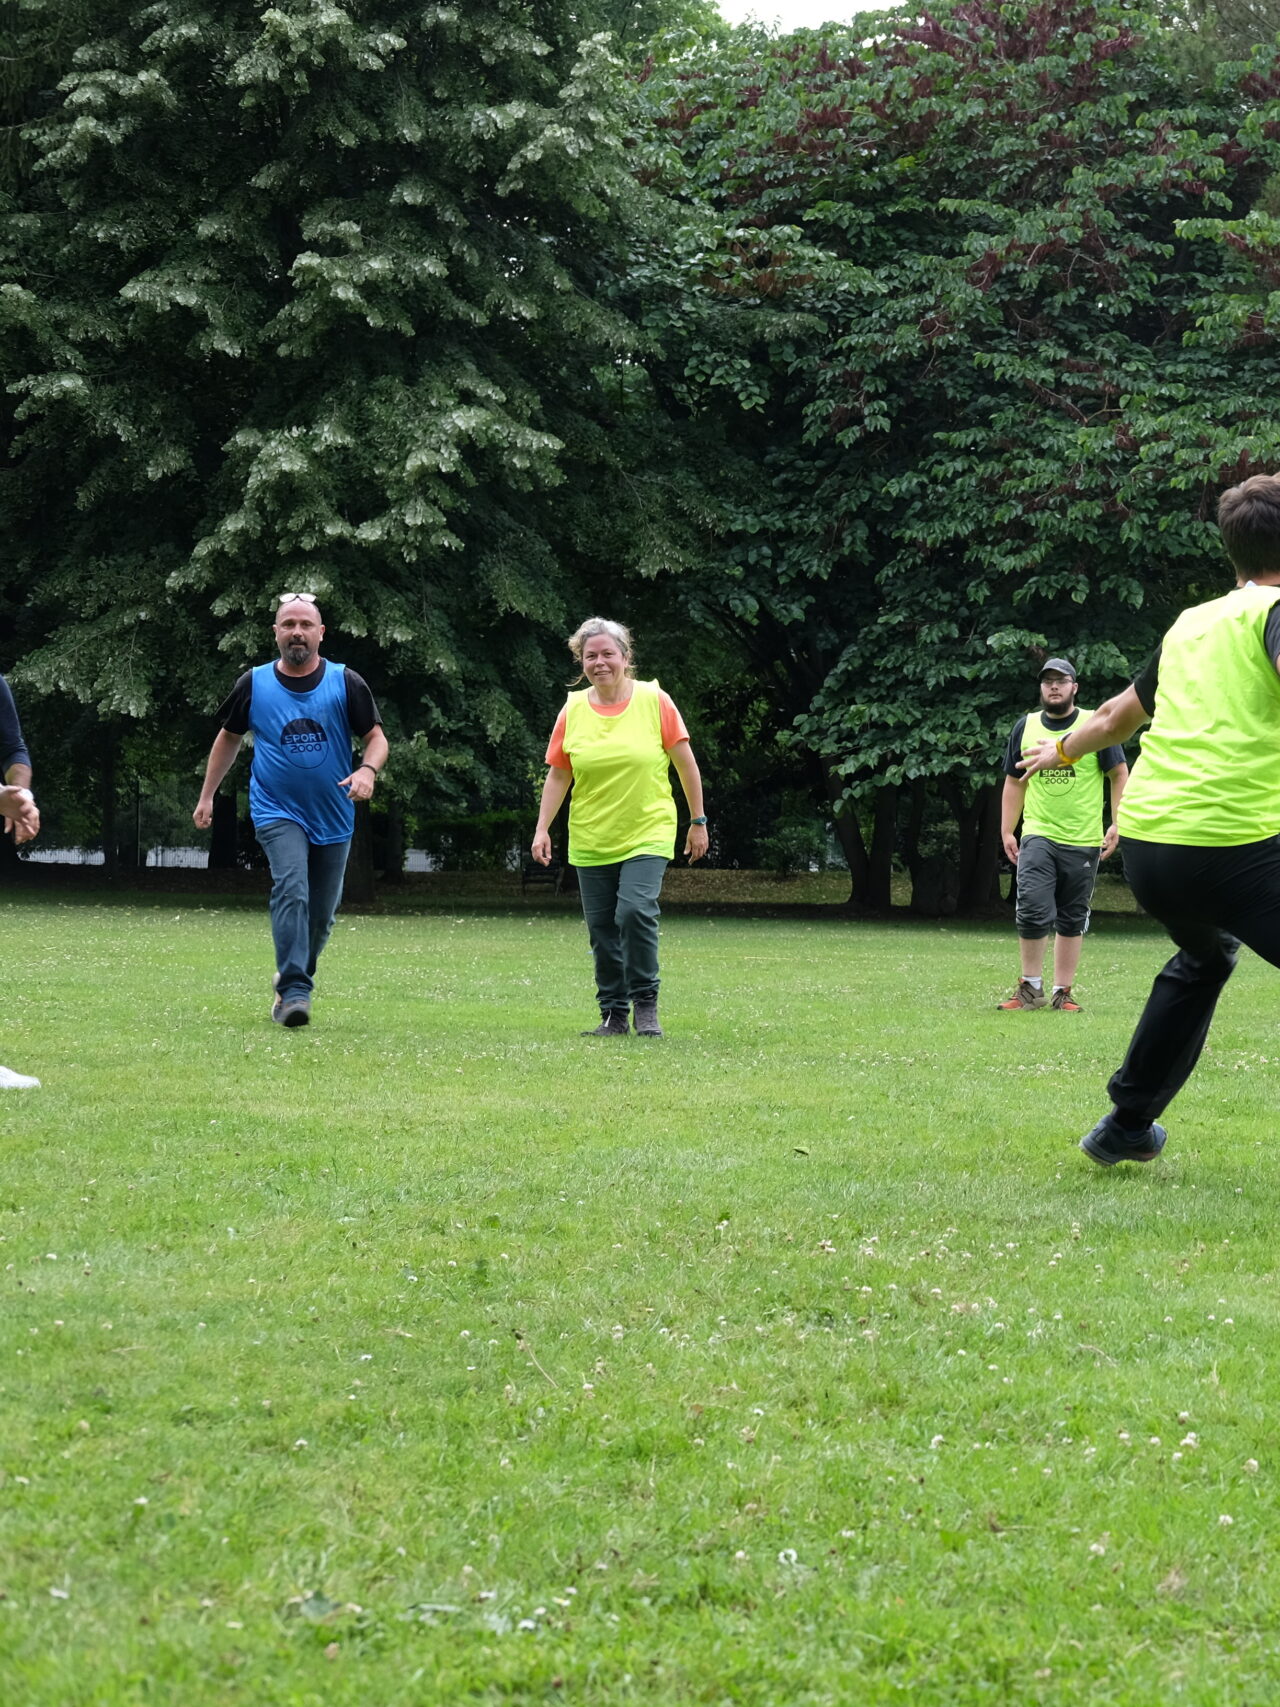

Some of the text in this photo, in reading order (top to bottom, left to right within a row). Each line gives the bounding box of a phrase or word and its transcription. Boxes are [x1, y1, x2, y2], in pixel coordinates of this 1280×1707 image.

[284, 732, 322, 744] SPORT
[290, 743, 322, 754] 2000
[1042, 769, 1073, 777] SPORT
[1044, 777, 1070, 785] 2000
